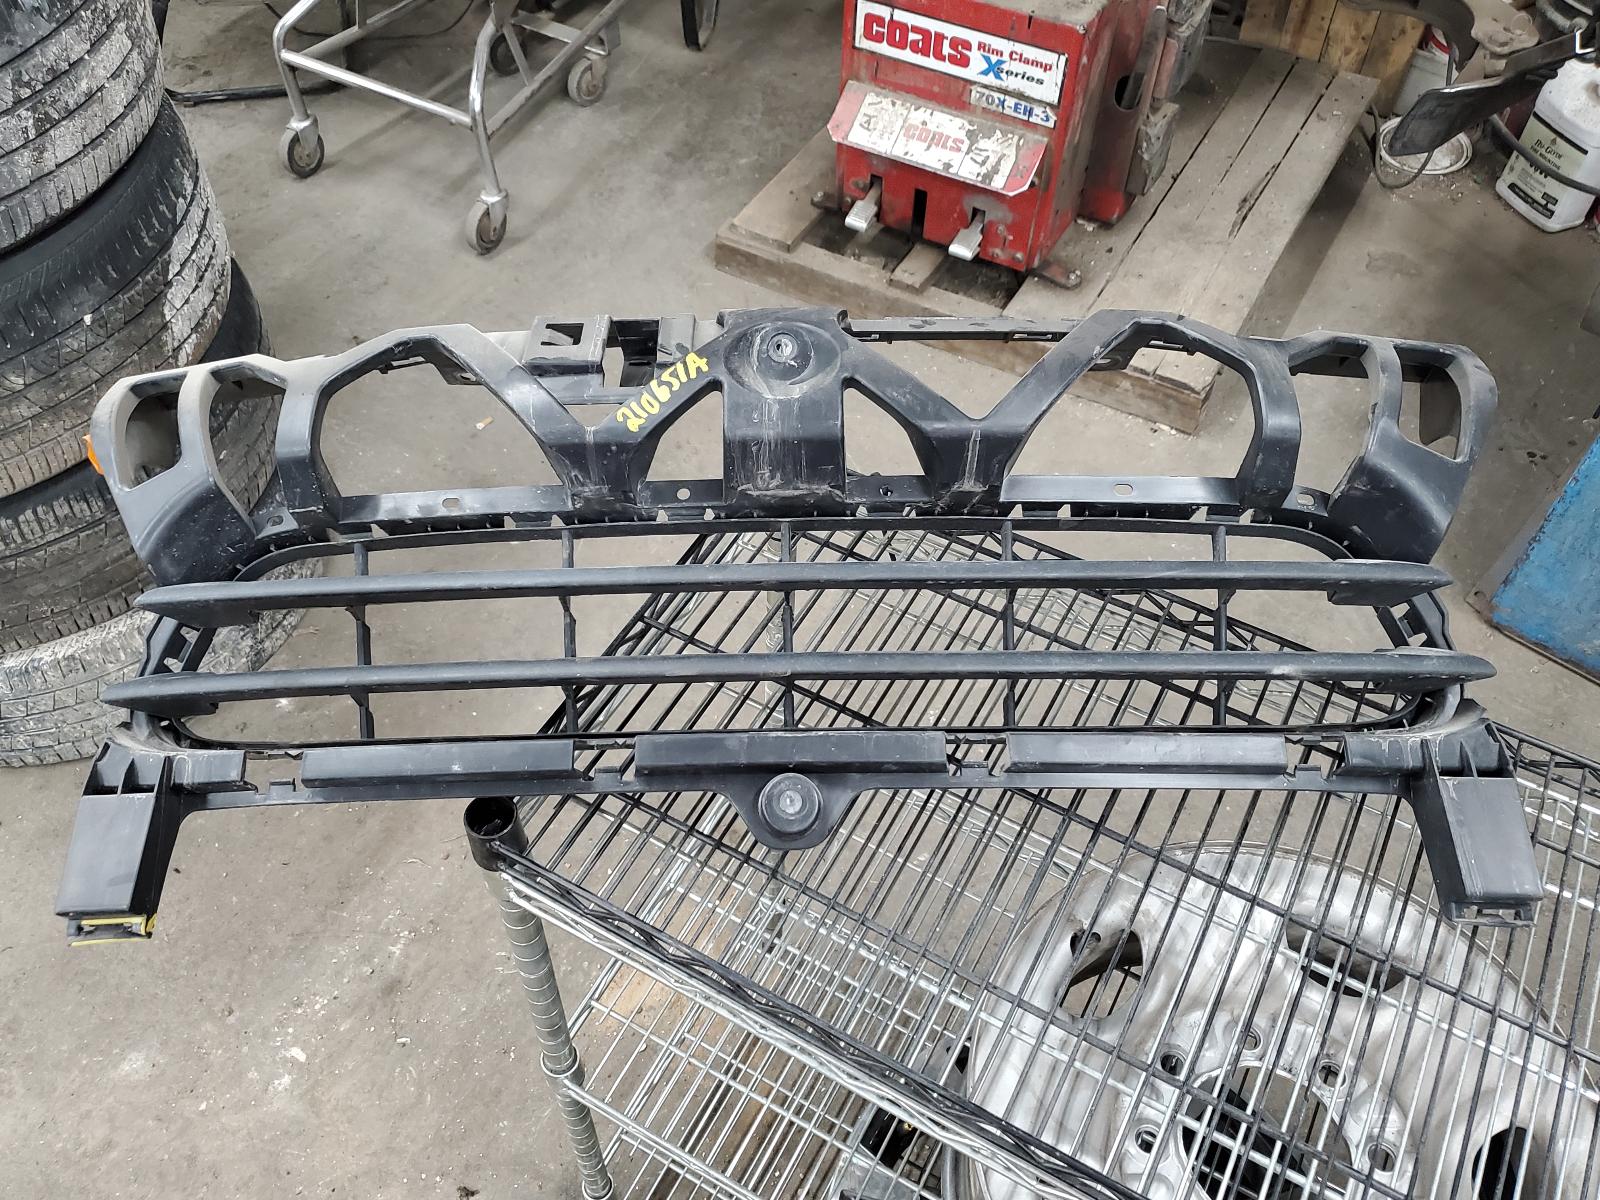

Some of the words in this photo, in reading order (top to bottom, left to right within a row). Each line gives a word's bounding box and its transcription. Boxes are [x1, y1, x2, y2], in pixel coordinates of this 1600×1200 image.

[977, 41, 1004, 58] Rim
[1009, 50, 1053, 73] Clamp
[616, 352, 709, 433] 210651A
